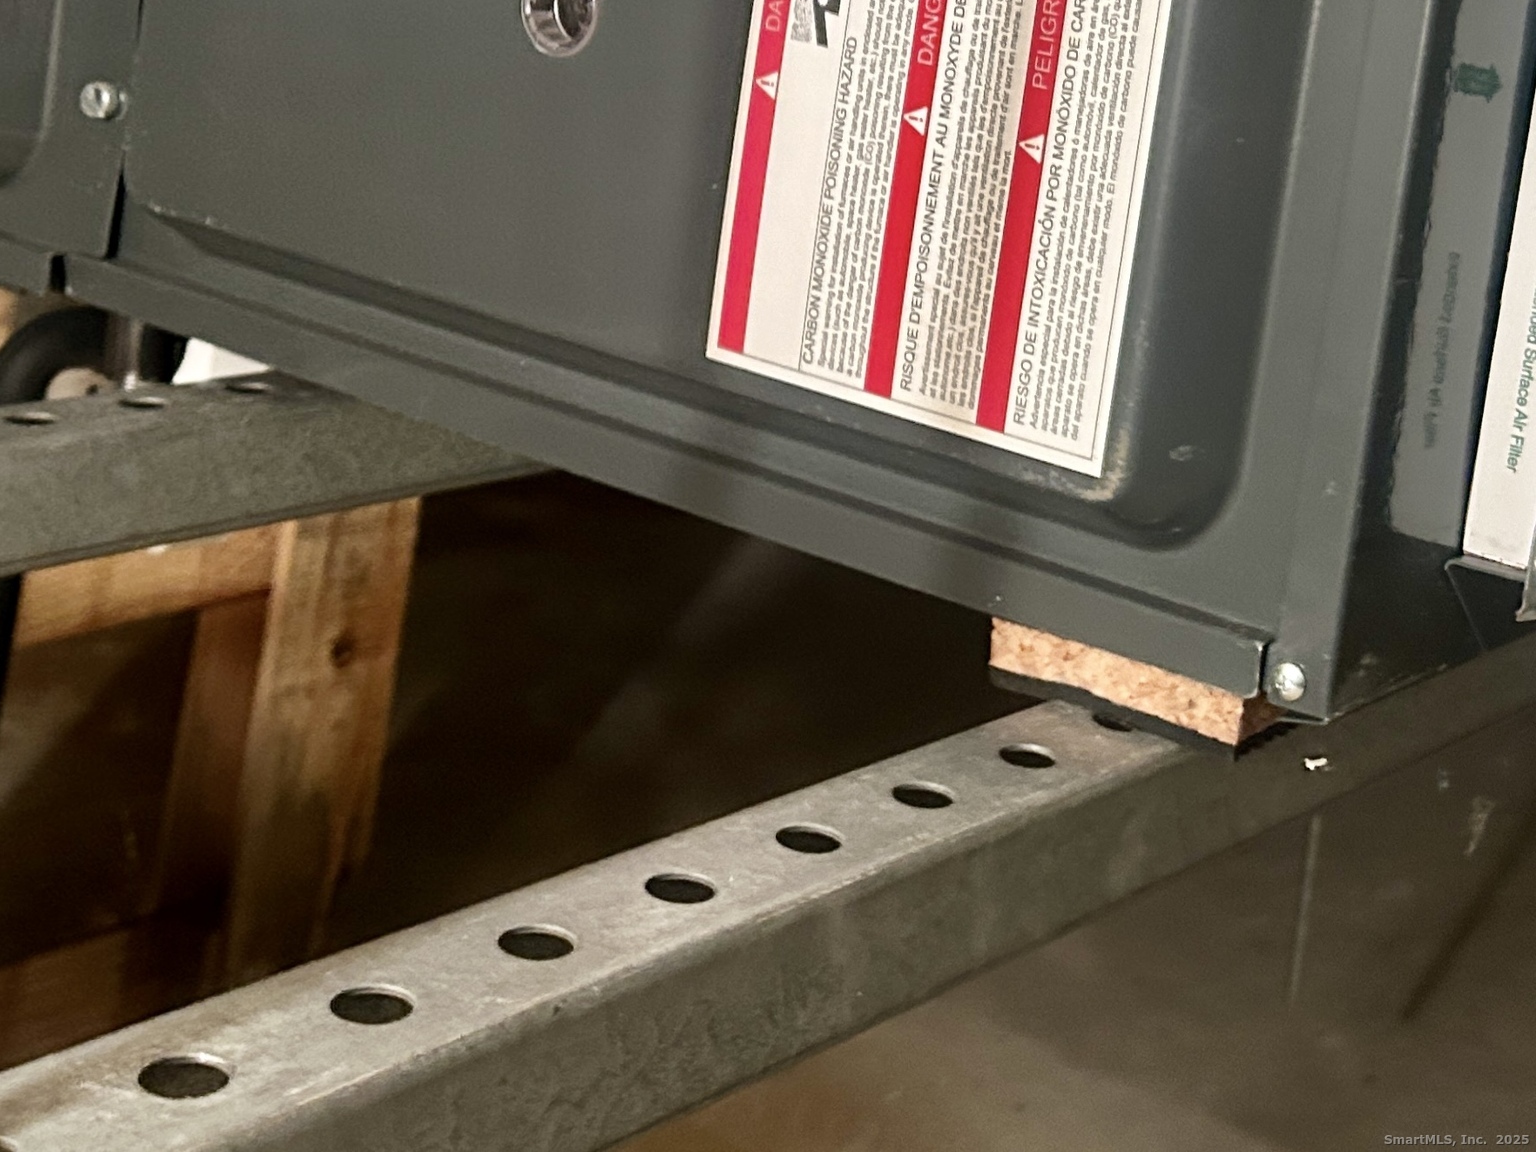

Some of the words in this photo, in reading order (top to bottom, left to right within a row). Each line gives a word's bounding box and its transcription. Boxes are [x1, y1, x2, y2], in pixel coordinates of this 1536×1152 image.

[836, 35, 857, 105] HAZARD
[937, 20, 963, 120] MONOXYDE
[1065, 35, 1081, 62] DE
[934, 121, 949, 147] AU
[1050, 63, 1077, 160] MONÓXIDO
[823, 106, 848, 201] POISONING
[1044, 162, 1062, 202] POR
[810, 202, 834, 293] MONOXIDE
[908, 150, 945, 325] D'EMPOISONNEMENT
[1026, 203, 1056, 328] INTOXICACIÓN
[800, 293, 821, 365] CARBON
[899, 326, 919, 391] RISQUE
[1022, 329, 1038, 356] DE
[1012, 357, 1034, 426] RIESGO
[1517, 348, 1536, 407] Surface
[1506, 434, 1524, 474] Filter
[1512, 409, 1529, 432] Air
